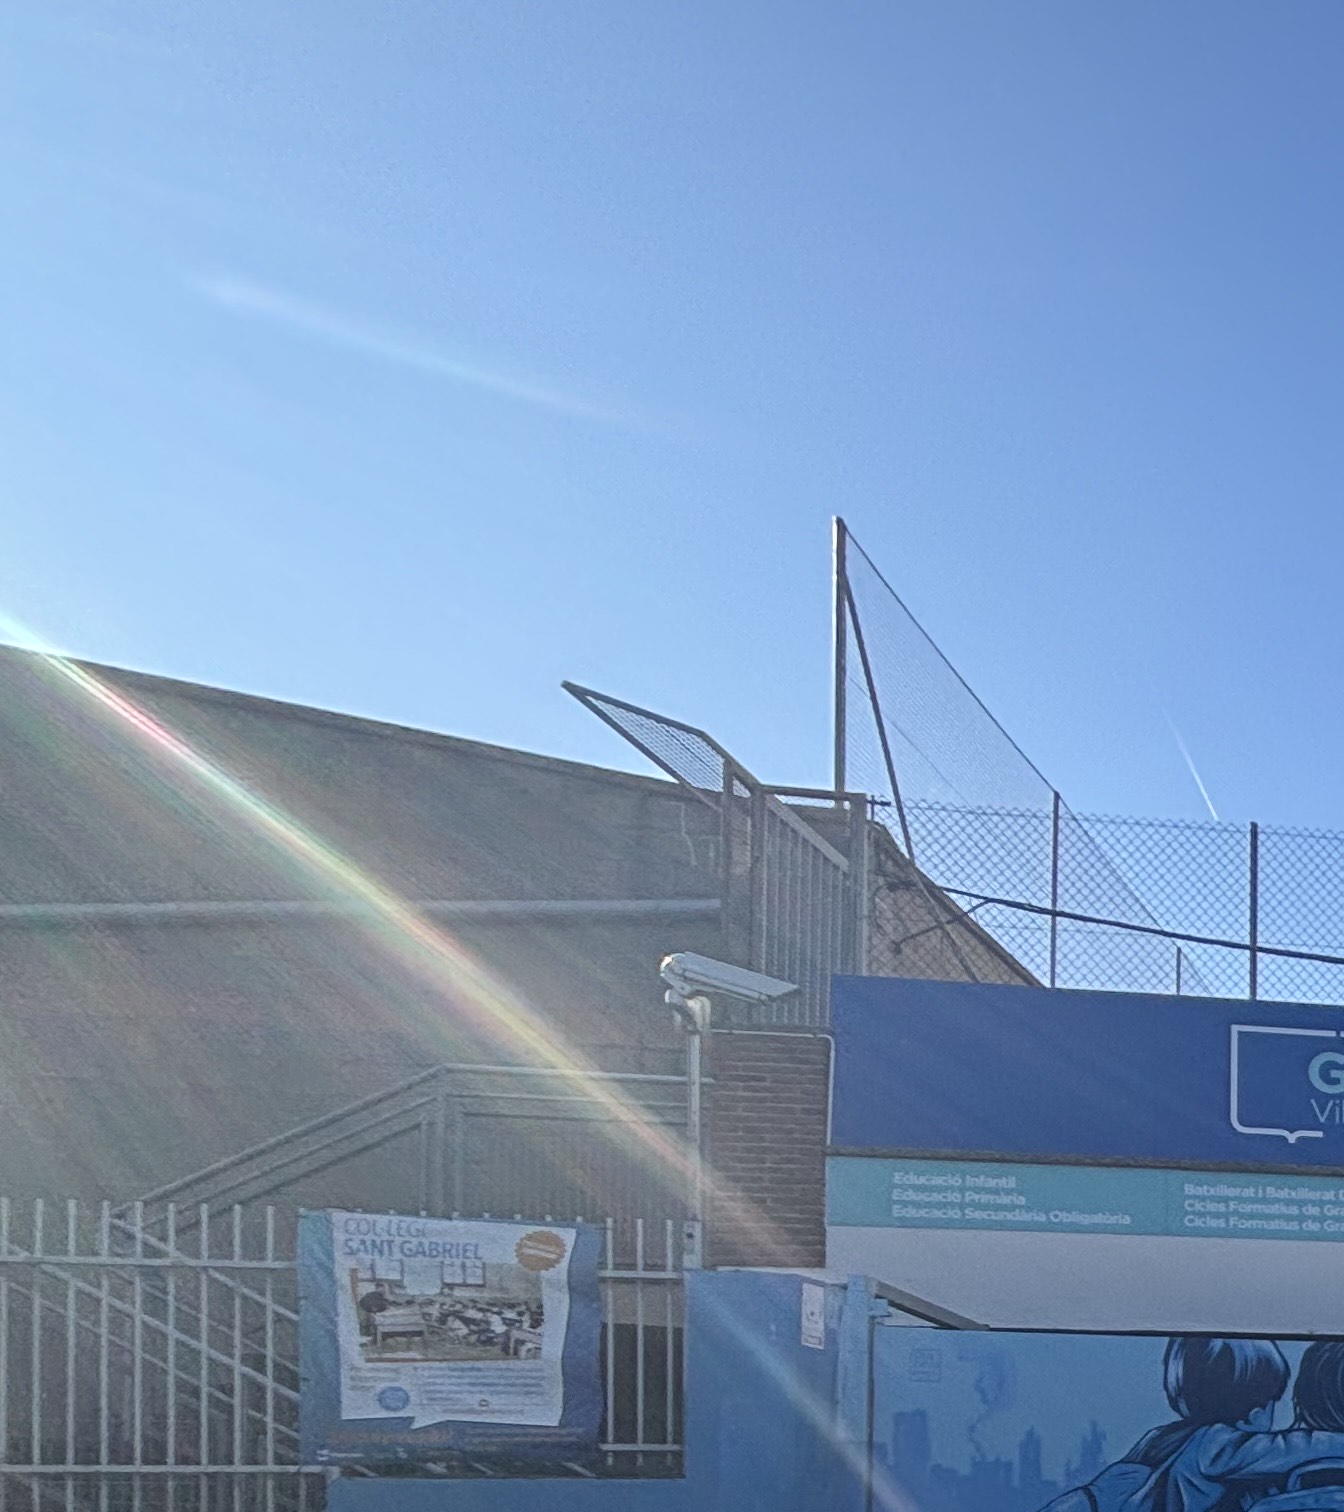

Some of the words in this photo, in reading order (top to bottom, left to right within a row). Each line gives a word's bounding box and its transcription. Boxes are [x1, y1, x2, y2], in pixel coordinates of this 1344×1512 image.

[893, 1171, 962, 1187] Educació
[965, 1174, 1016, 1189] Infantil
[892, 1188, 962, 1203] Educació
[1184, 1183, 1256, 1198] Batxillerat
[1266, 1186, 1336, 1201] Batxillerat
[892, 1204, 962, 1219] Educació
[1184, 1199, 1226, 1213] Cicles
[1230, 1201, 1299, 1216] Formatius
[1303, 1203, 1321, 1216] de
[1184, 1215, 1226, 1229] Cicles
[1229, 1216, 1299, 1231] Formatius
[1302, 1218, 1321, 1232] de
[344, 1238, 394, 1257] SANT
[400, 1241, 484, 1261] GABRIEL
